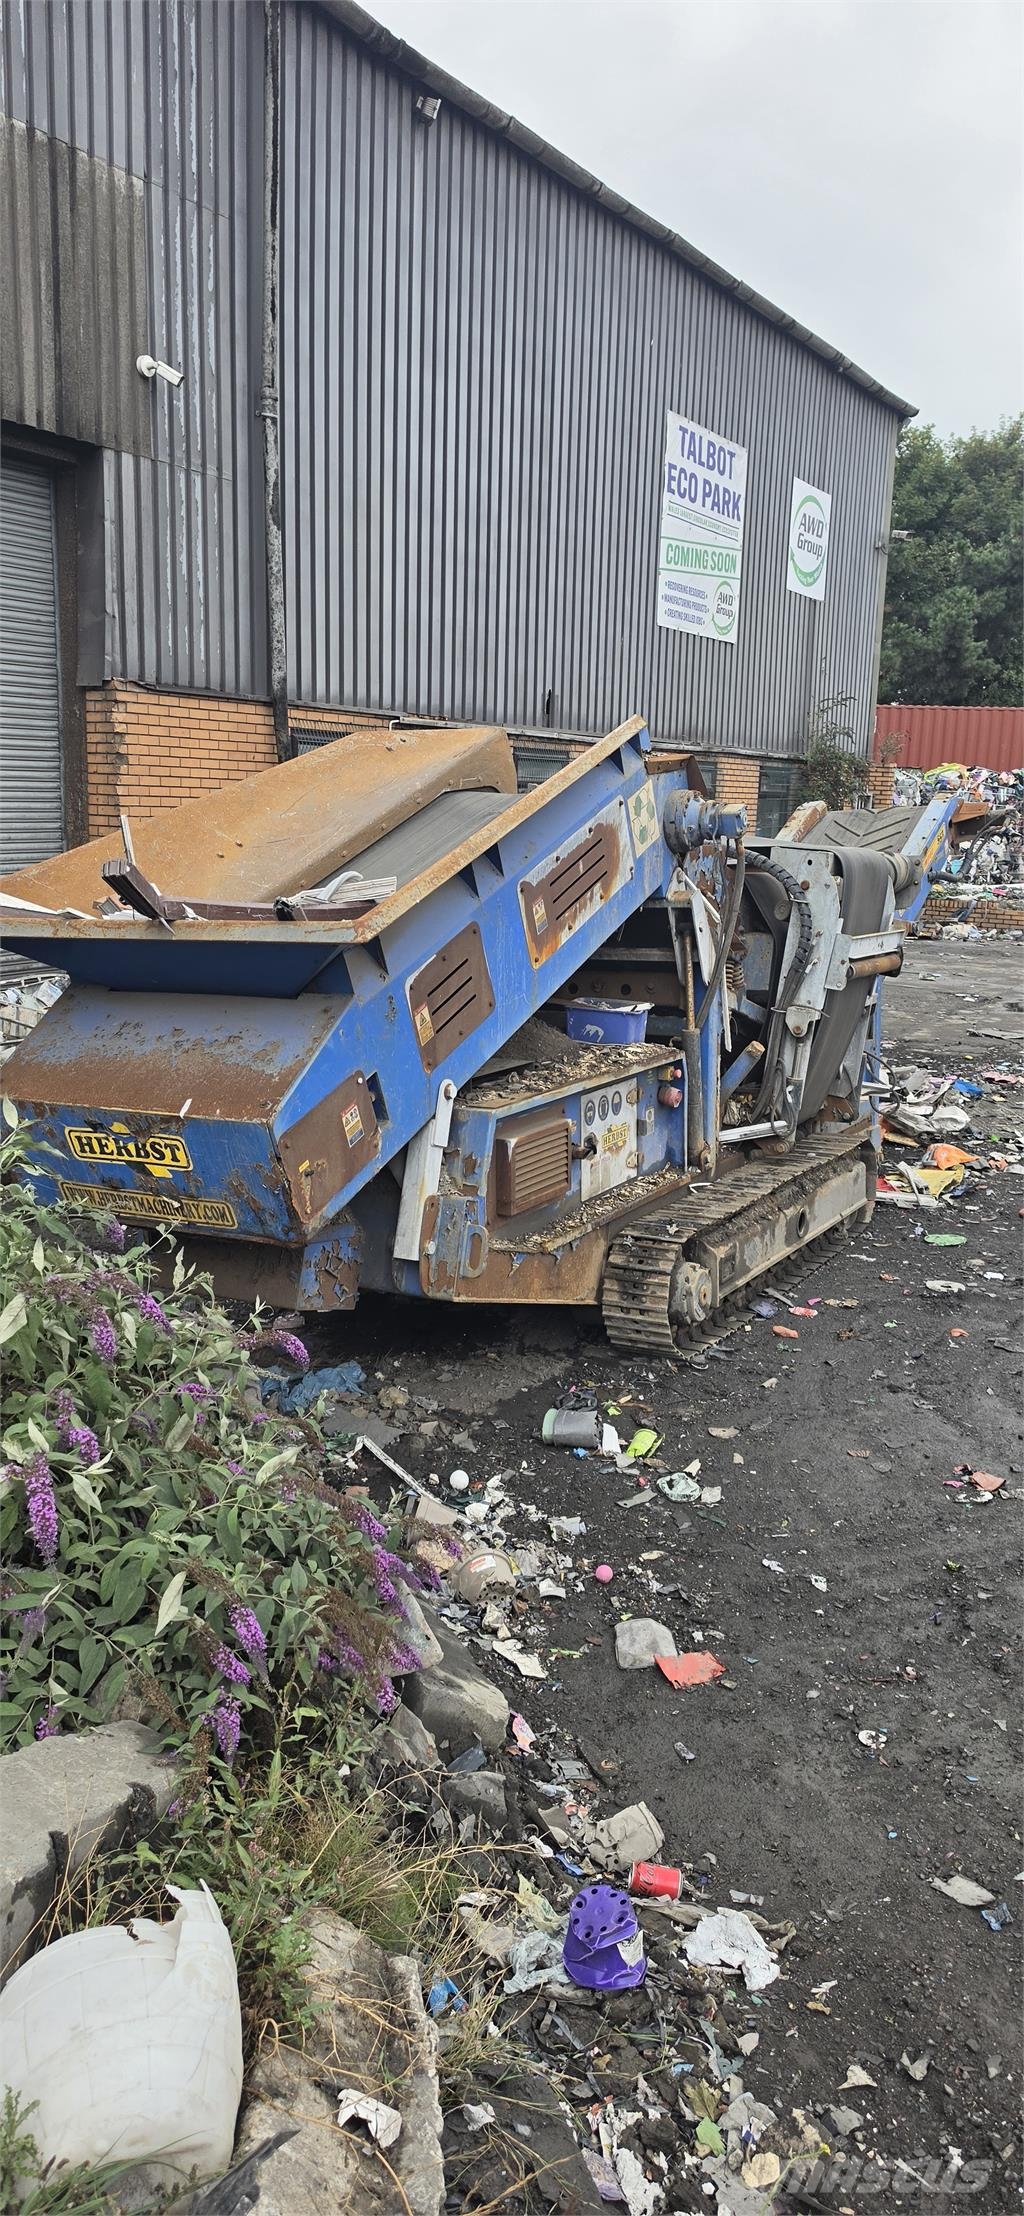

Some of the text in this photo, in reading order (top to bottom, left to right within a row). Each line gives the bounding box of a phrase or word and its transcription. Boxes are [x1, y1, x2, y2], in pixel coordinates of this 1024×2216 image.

[679, 425, 736, 480] TALBOT
[667, 462, 698, 504] ECO
[702, 478, 742, 522] PARK
[798, 512, 825, 539] AWD
[666, 543, 737, 574] COMING SOON
[797, 532, 823, 561] Group
[715, 603, 734, 620] Group
[717, 592, 734, 607] AWD
[74, 1135, 182, 1163] HERBST
